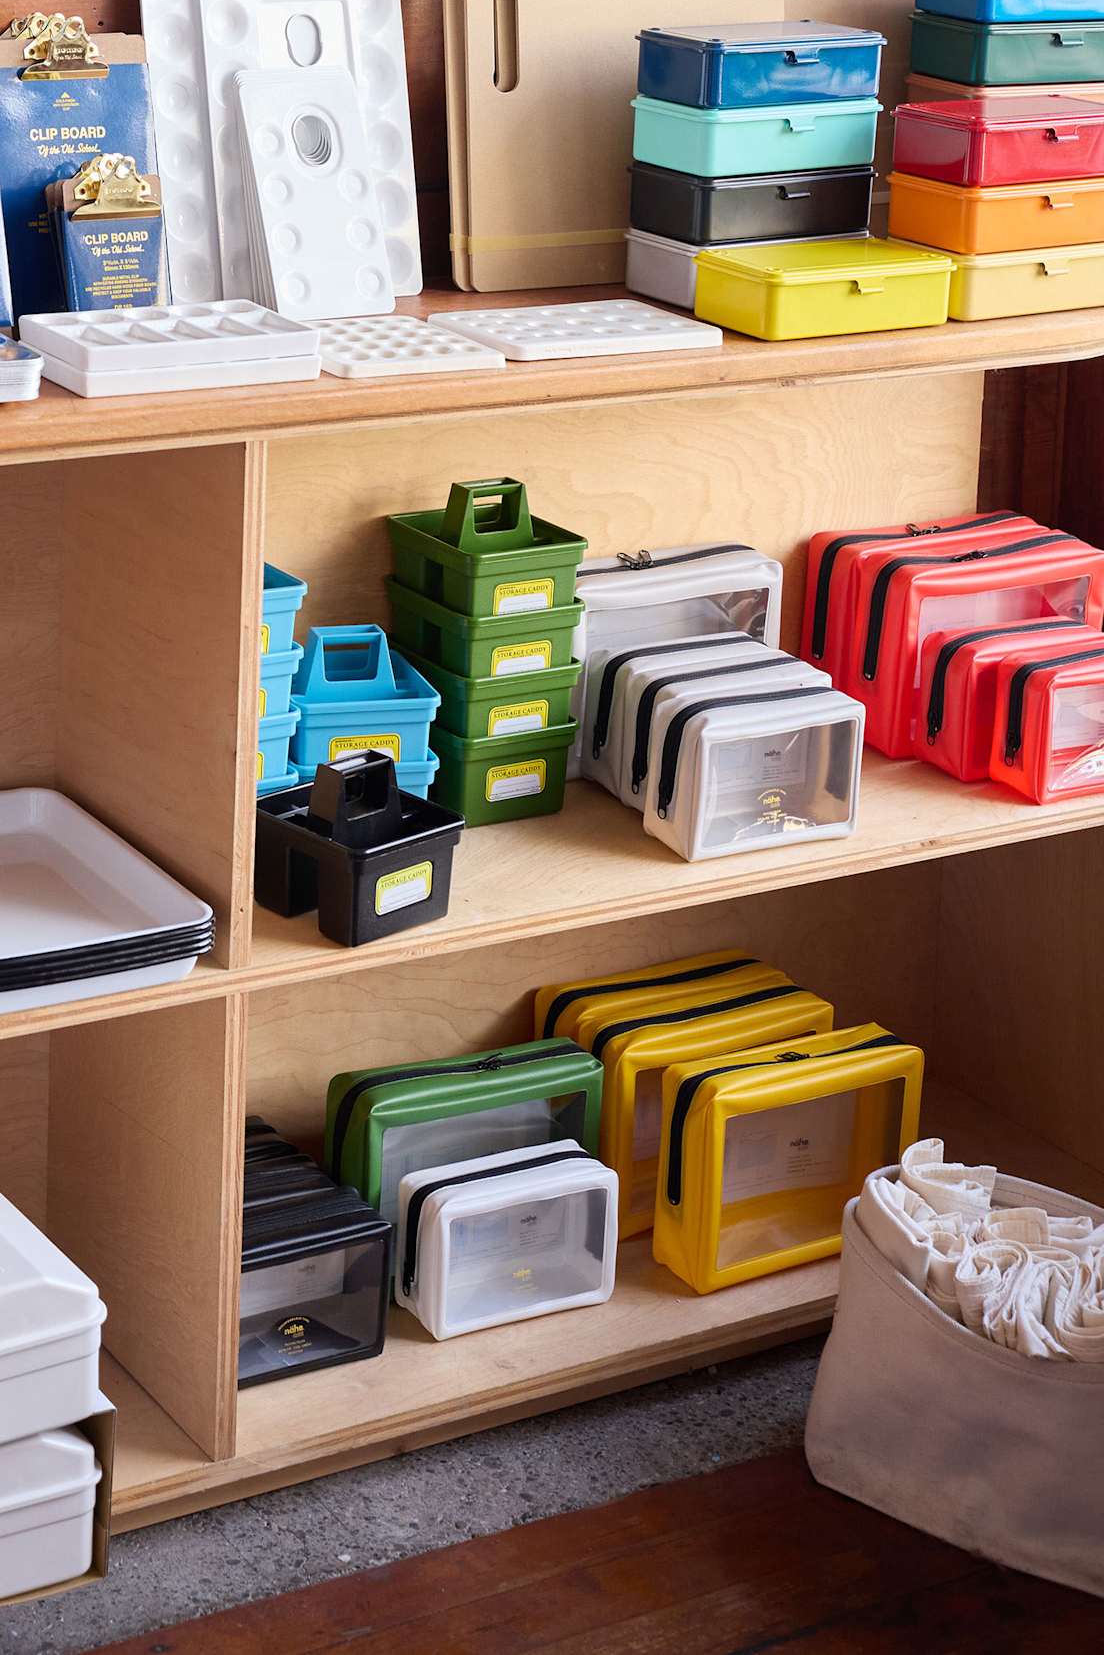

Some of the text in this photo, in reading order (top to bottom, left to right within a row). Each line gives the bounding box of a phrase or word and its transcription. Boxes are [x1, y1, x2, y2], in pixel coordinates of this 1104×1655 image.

[29, 126, 106, 141] CLIP BOARD
[37, 145, 49, 158] Of
[61, 143, 75, 154] Old
[84, 230, 149, 246] CLIP BOARD
[499, 585, 549, 595] STORAGE CADDY
[497, 646, 547, 659] STORAGE CADDY
[494, 706, 543, 718] STORAGE CADDY
[491, 765, 542, 778] STORAGE CADDY
